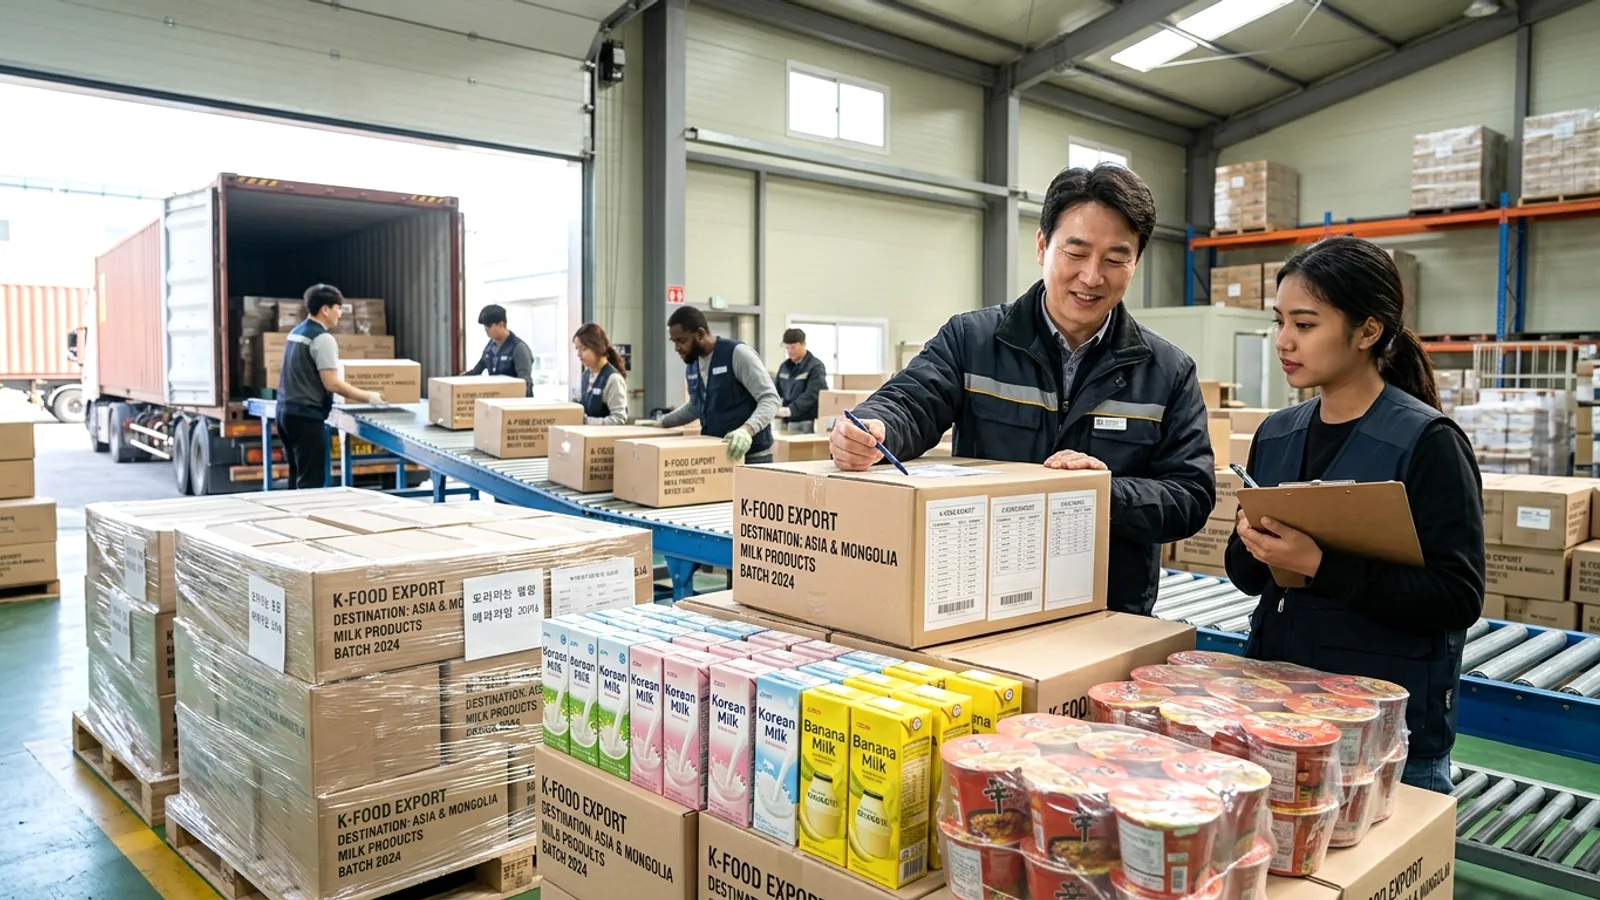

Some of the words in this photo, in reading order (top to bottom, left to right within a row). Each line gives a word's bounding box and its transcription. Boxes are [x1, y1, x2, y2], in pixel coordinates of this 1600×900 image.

[741, 498, 784, 522] K-FOOD
[788, 505, 838, 531] EXPORT
[741, 523, 803, 548] DESTINATION:
[804, 535, 828, 554] ASIA
[830, 539, 838, 555] &
[841, 541, 898, 567] MONGOLIA
[741, 543, 763, 560] MILK
[765, 548, 816, 572] PRODUCTS
[741, 563, 769, 583] BATCH
[771, 571, 795, 589] 2024
[332, 587, 388, 608] K-FOOD
[392, 580, 446, 601] EXPORT
[333, 605, 410, 627] DESTINATION:
[411, 600, 436, 616] ASIA
[438, 599, 447, 612] &
[333, 627, 362, 643] MILK
[365, 619, 423, 639] PRODUCTS
[333, 642, 371, 660] BATCH
[373, 638, 400, 653] 2024
[712, 693, 746, 716] Korean
[717, 710, 739, 729] Milk
[758, 706, 796, 730] Korean
[804, 719, 845, 743] Banana
[812, 736, 836, 756] Milk
[853, 734, 896, 760] Banana
[337, 802, 391, 829] K-FOOD
[395, 788, 447, 815] EXPORT
[541, 775, 580, 811] K-FOOD
[583, 796, 627, 835] EXPORT
[338, 818, 410, 846] DESTINATION:
[412, 811, 436, 827] ASIA
[438, 807, 446, 819] &
[449, 793, 498, 816] MONGOLIA
[338, 844, 365, 862] MILK
[542, 839, 566, 864] BATCH
[594, 830, 614, 851] ASIA
[616, 841, 623, 857] &
[624, 844, 674, 883] MONGOLIA
[338, 859, 373, 878] BATCH
[708, 845, 761, 889] K-FOOD
